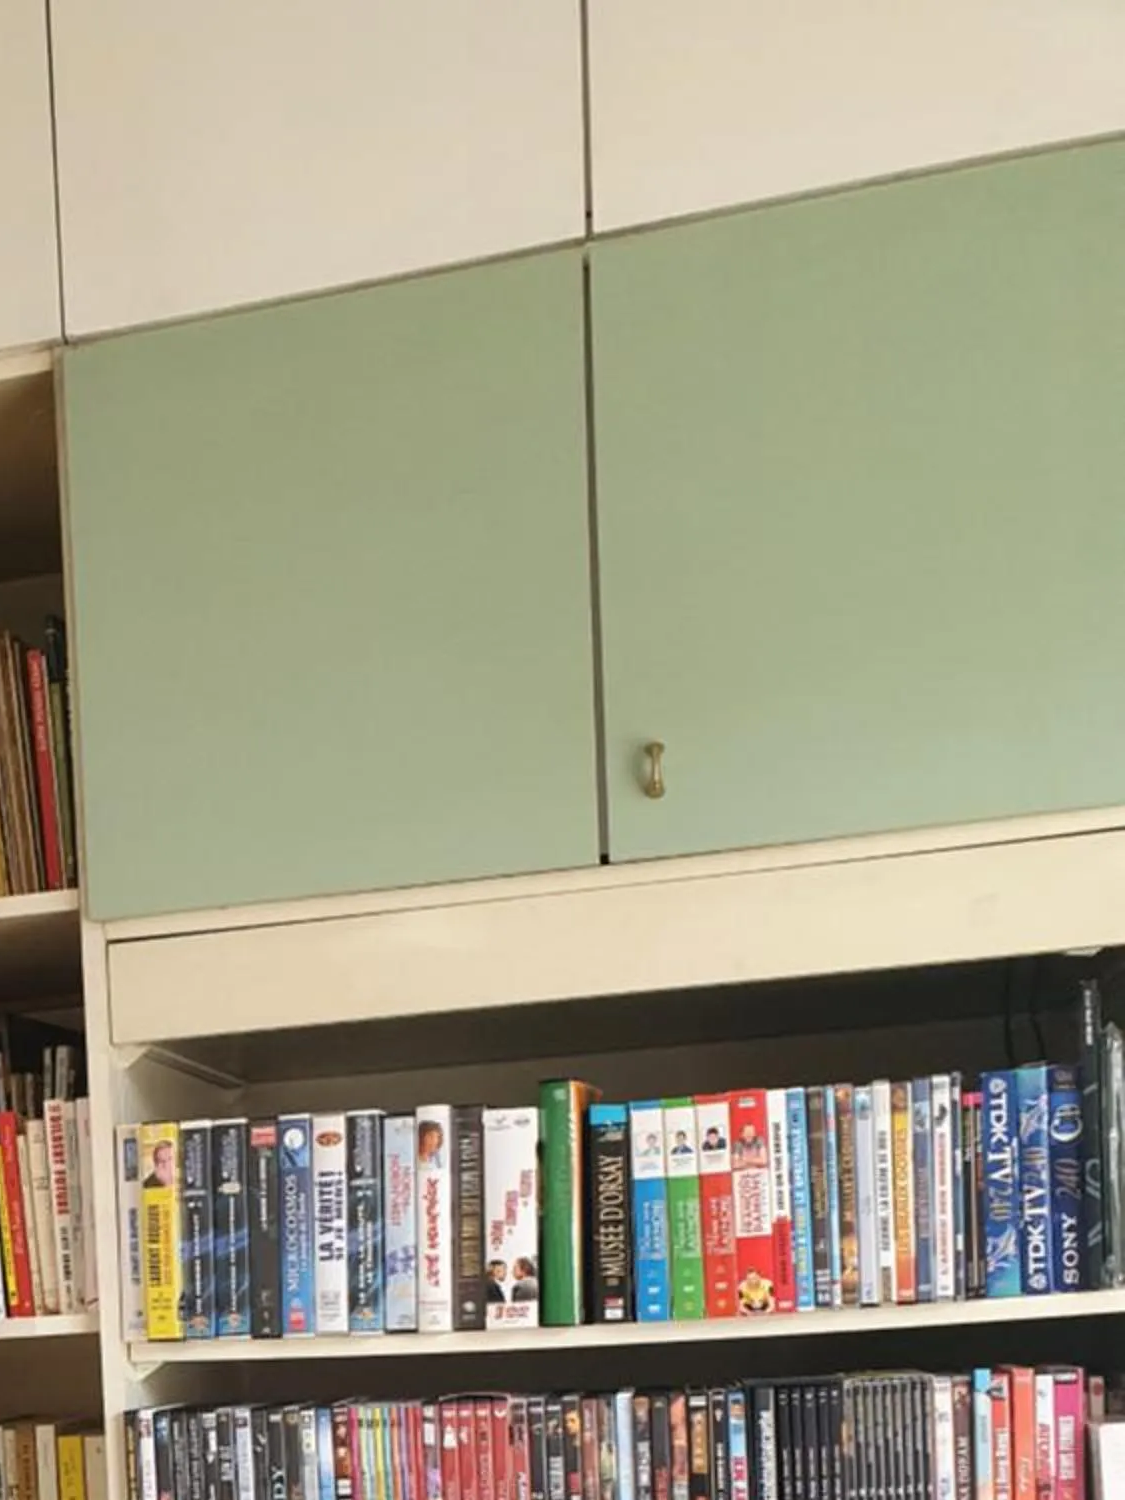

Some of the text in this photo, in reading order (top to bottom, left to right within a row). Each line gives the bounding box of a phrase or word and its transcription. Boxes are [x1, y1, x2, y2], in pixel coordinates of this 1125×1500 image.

[49, 1114, 67, 1166] DILBERT
[990, 1091, 1009, 1145] TDK
[54, 1169, 71, 1216] FUTURE
[986, 1147, 1012, 1186] TV
[1054, 1158, 1083, 1200] 240
[316, 1179, 335, 1235] VÉRITÉ
[593, 1154, 625, 1277] MUSÉE D'ORSAY
[1024, 1184, 1049, 1222] TV
[284, 1174, 300, 1293] MICROCOSMOS
[319, 1241, 335, 1262] LA
[1026, 1223, 1046, 1275] TDK
[1061, 1212, 1080, 1285] SONY
[957, 1436, 970, 1483] DREAM
